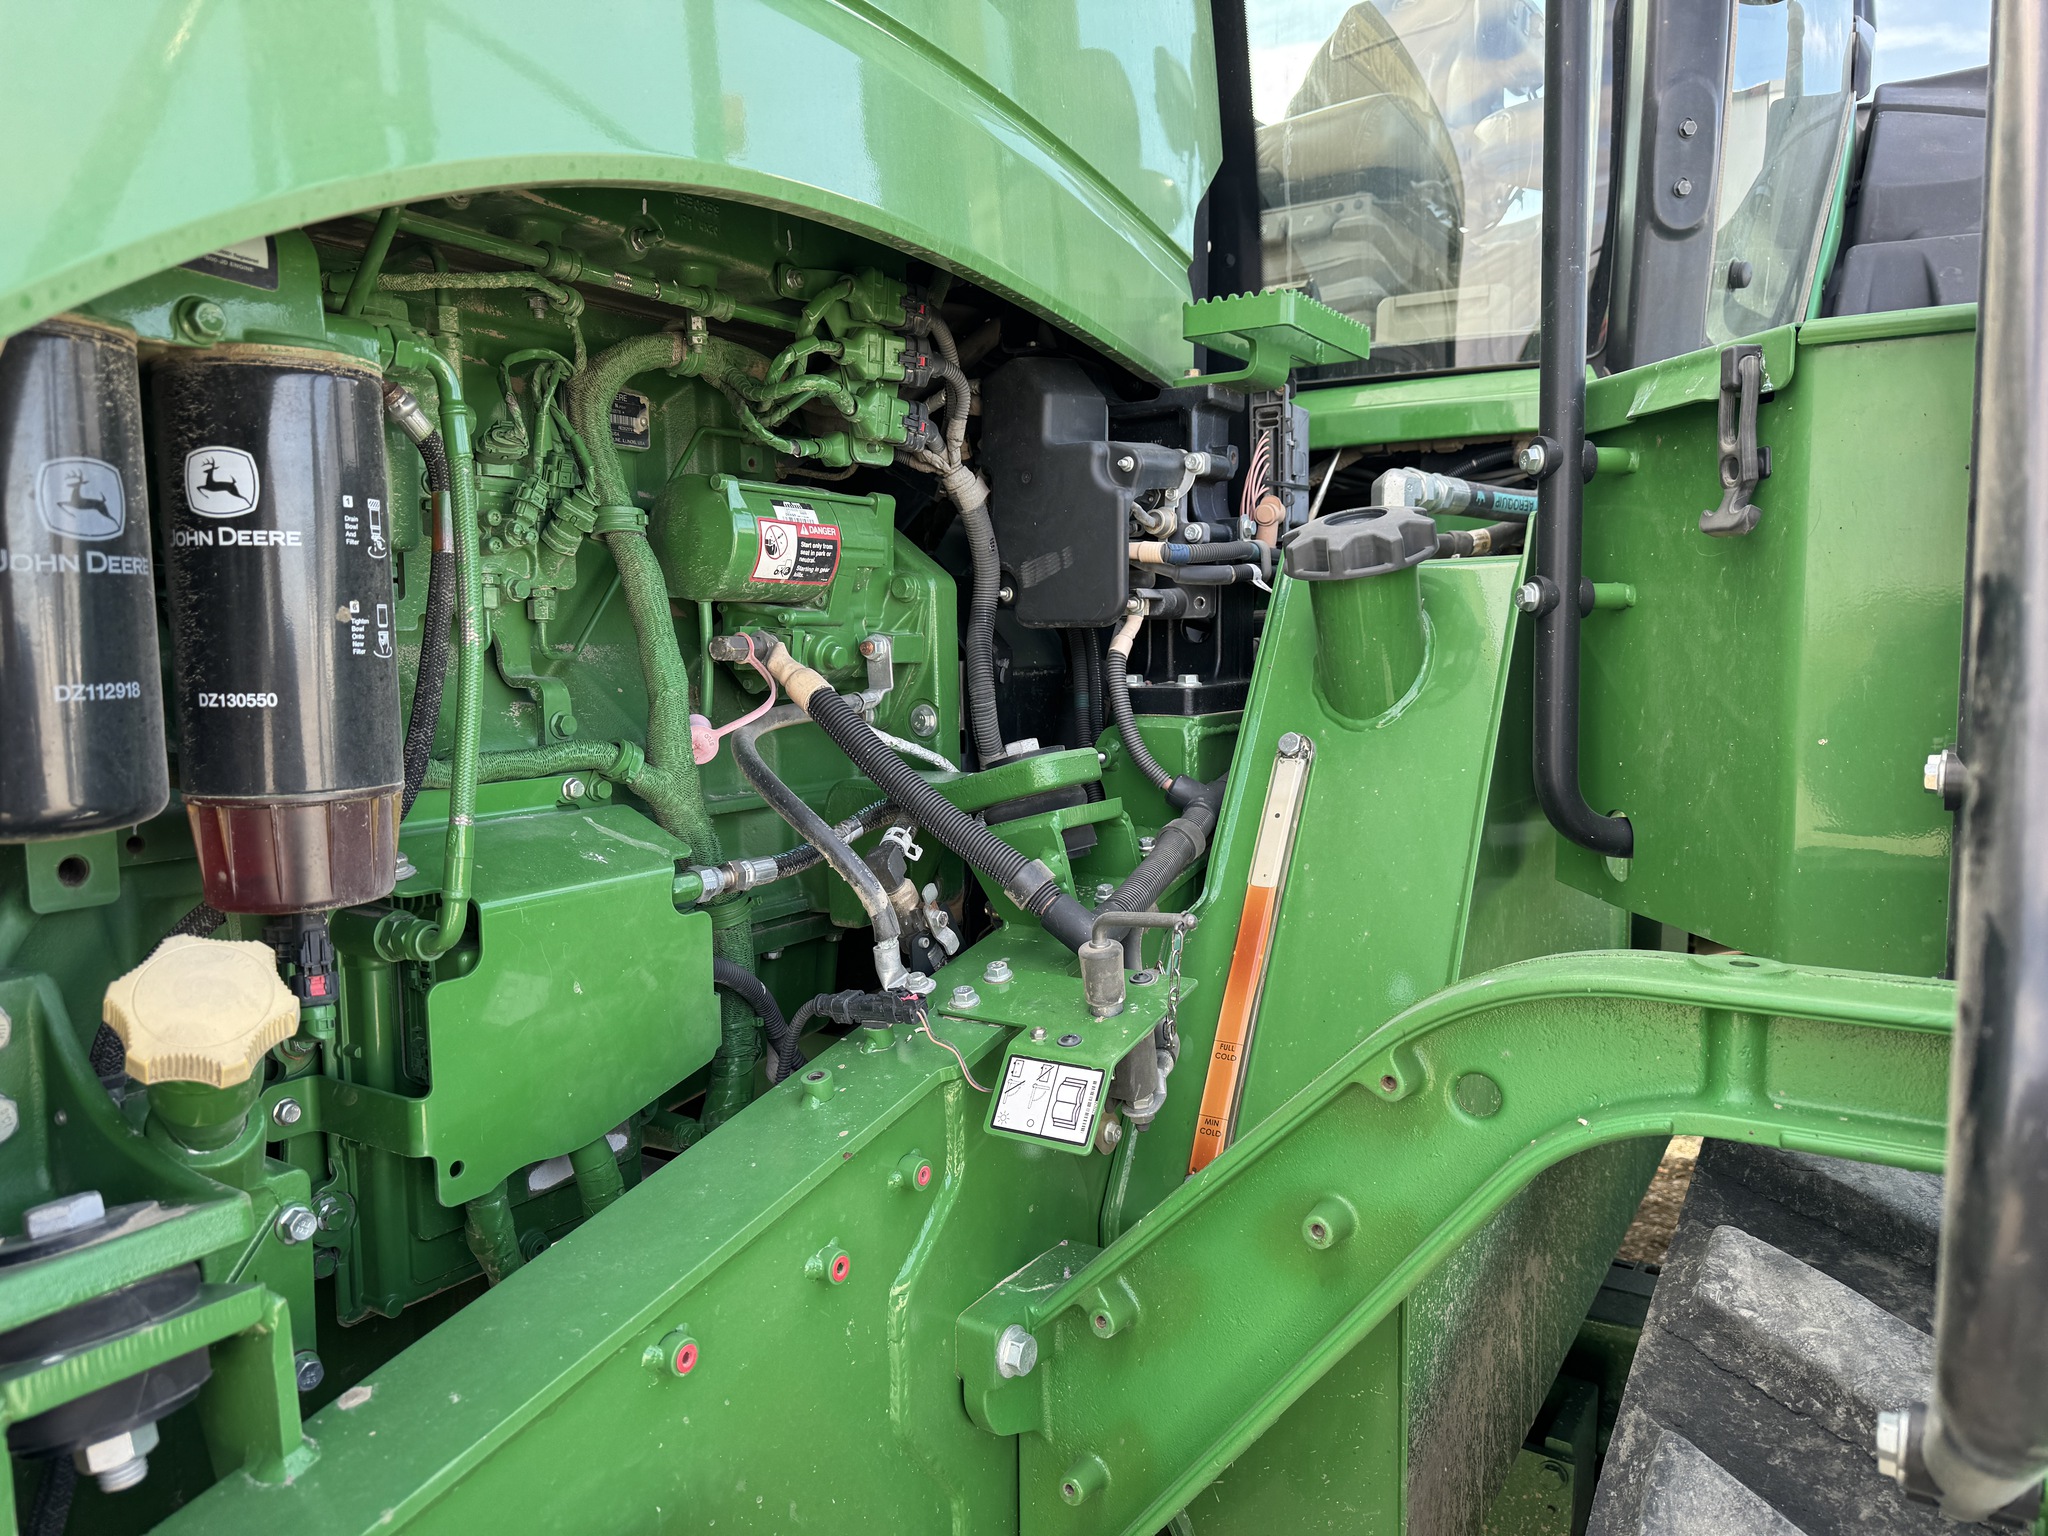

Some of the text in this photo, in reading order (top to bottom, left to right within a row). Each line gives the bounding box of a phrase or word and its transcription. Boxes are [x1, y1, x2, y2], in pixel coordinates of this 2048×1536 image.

[344, 515, 359, 523] Drain
[808, 526, 837, 536] DANGER
[170, 526, 303, 547] JOHN DEERE
[345, 538, 360, 546] Filter
[800, 541, 812, 549] Start
[812, 542, 822, 550] only
[0, 548, 149, 576] JOHN DEERE
[796, 565, 814, 573] Starting
[352, 640, 365, 648] New
[54, 681, 142, 703] DZ112918
[199, 692, 278, 708] DZ130550
[1219, 1043, 1235, 1052] FULL
[1215, 1052, 1237, 1062] COLD
[1204, 1118, 1220, 1127] MIN
[1200, 1127, 1222, 1138] COLD
